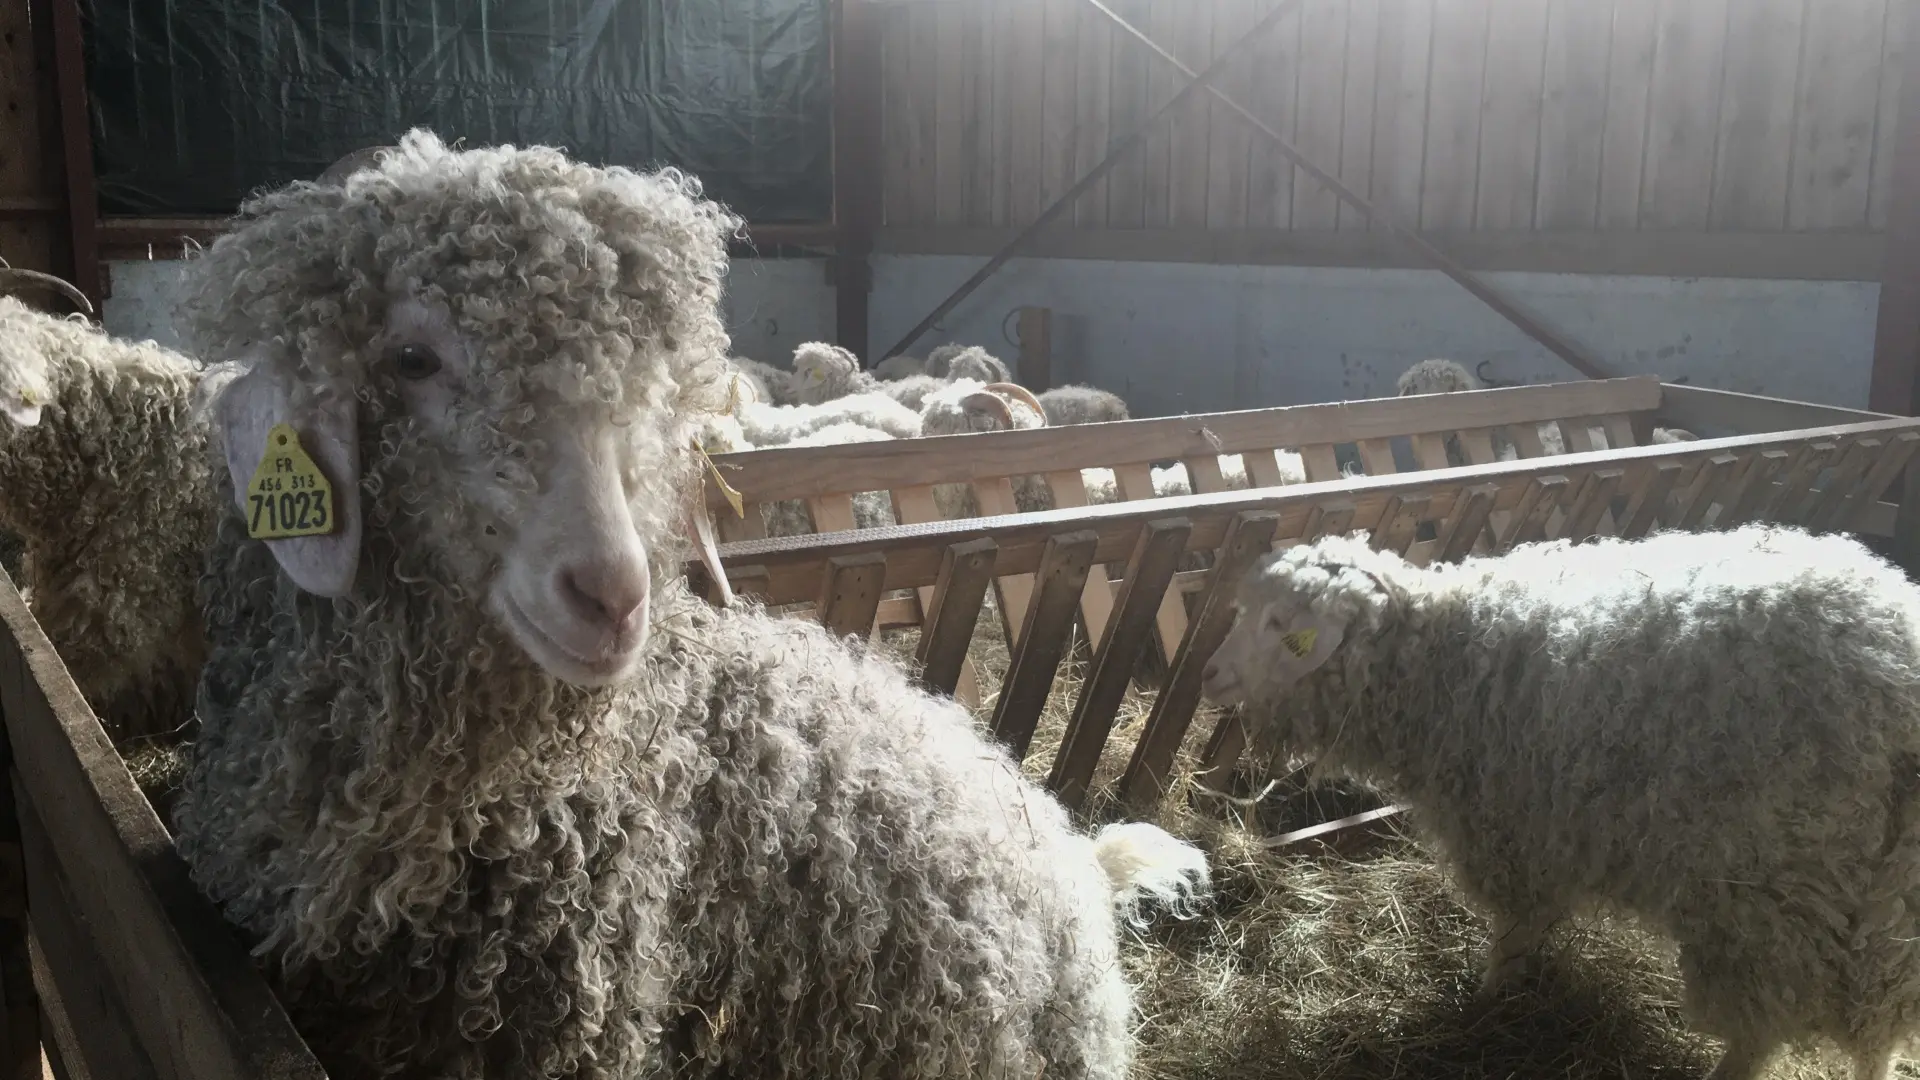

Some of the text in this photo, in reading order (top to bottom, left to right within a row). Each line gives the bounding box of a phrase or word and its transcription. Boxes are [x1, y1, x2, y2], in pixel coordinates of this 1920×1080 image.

[276, 457, 293, 473] FR
[259, 474, 315, 491] 456 313
[250, 490, 327, 532] 71023
